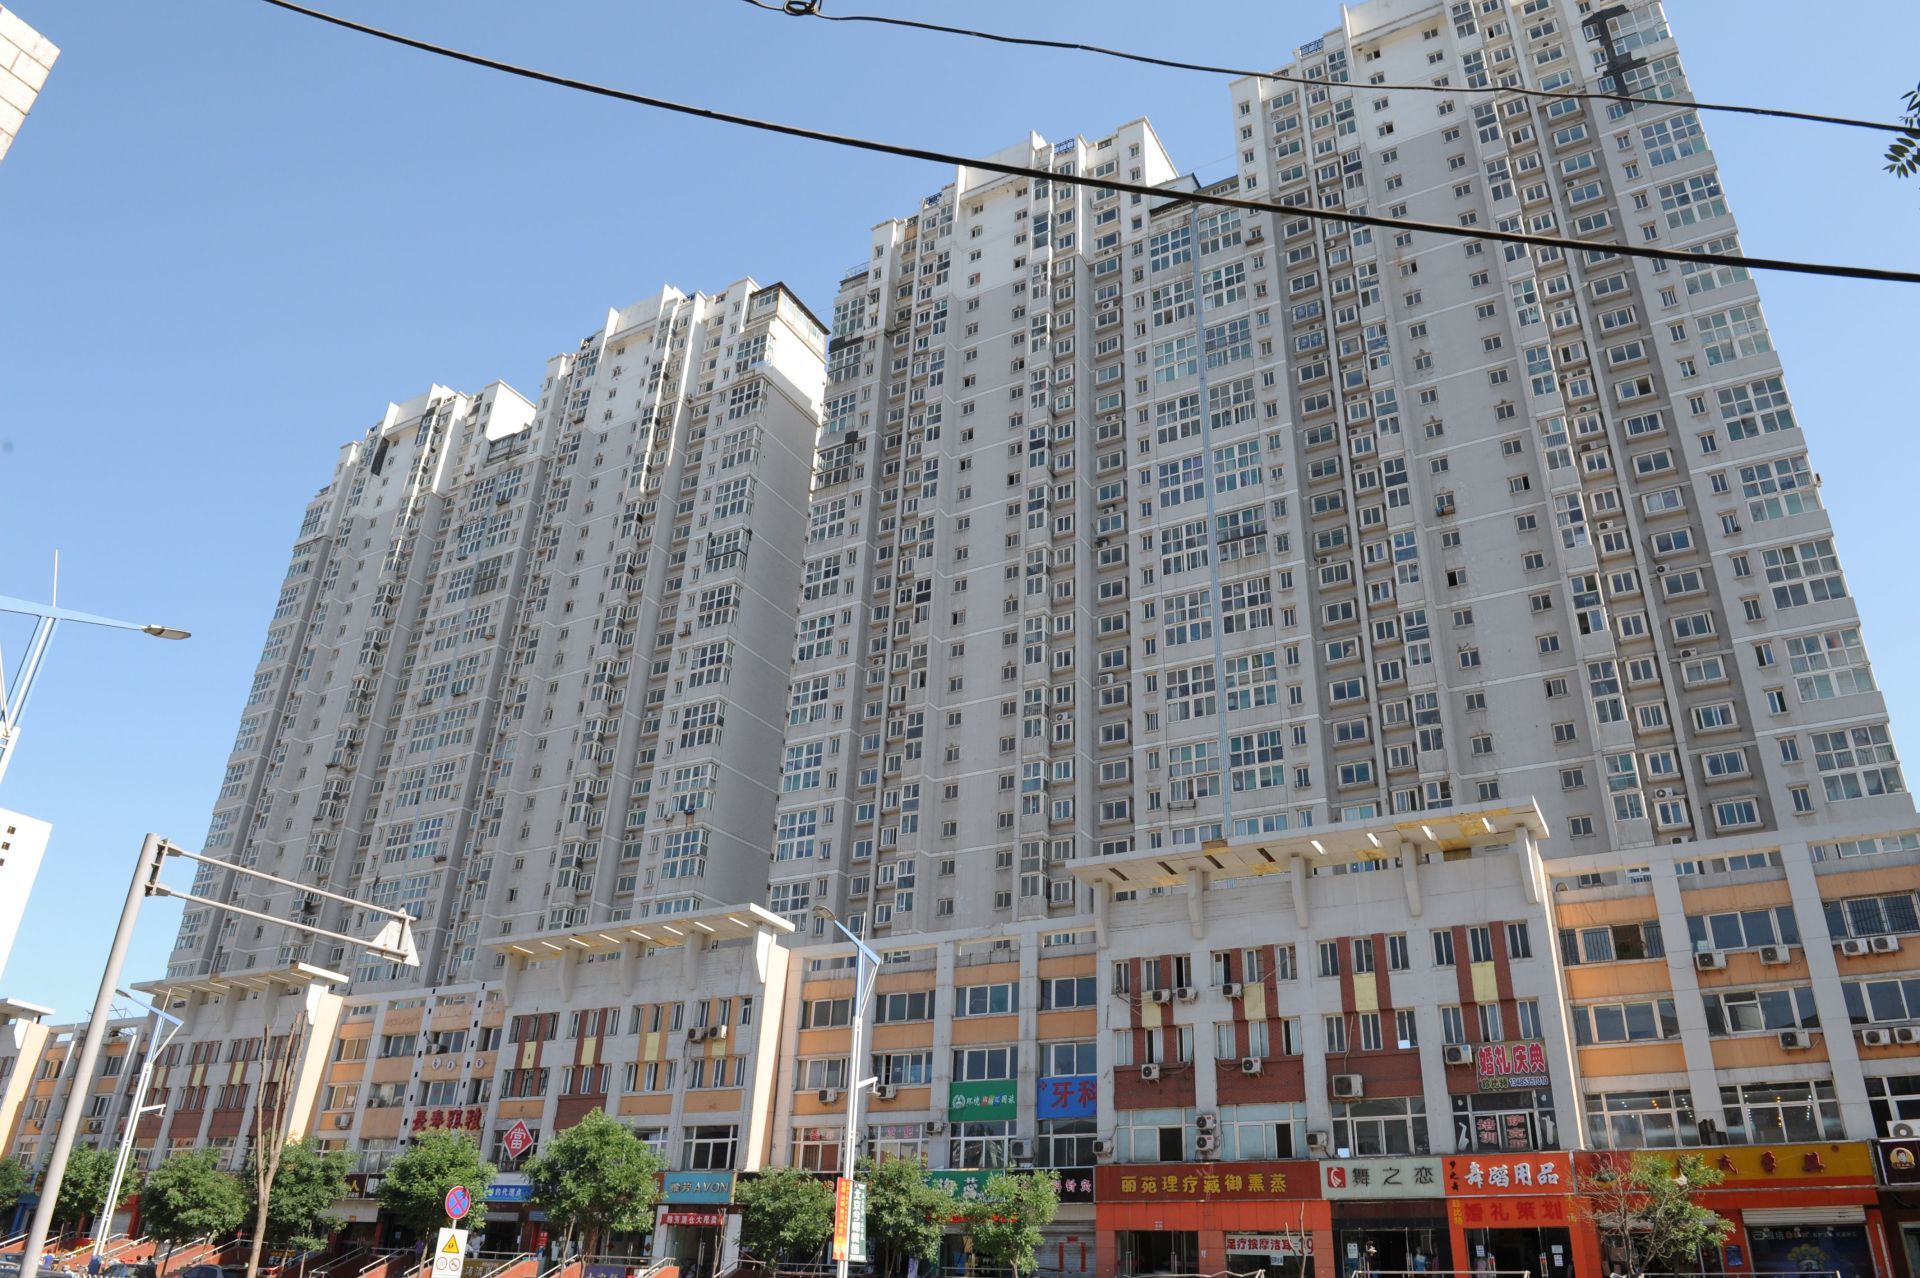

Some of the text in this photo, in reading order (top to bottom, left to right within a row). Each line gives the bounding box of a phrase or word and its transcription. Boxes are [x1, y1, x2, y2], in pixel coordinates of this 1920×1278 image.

[1478, 1042, 1546, 1075] 婚礼庆典
[1050, 1081, 1098, 1109] 牙科
[510, 1127, 526, 1150] 當
[1477, 1118, 1498, 1145] 培训
[1120, 1173, 1287, 1194] 丽苑理疗藏御熏蒸
[1352, 1166, 1434, 1187] 舞之恋
[1464, 1161, 1560, 1189] 舞蹈用品
[671, 1182, 692, 1193] 雅芳
[693, 1181, 730, 1193] AVON
[1464, 1200, 1563, 1223] 婚礼策划
